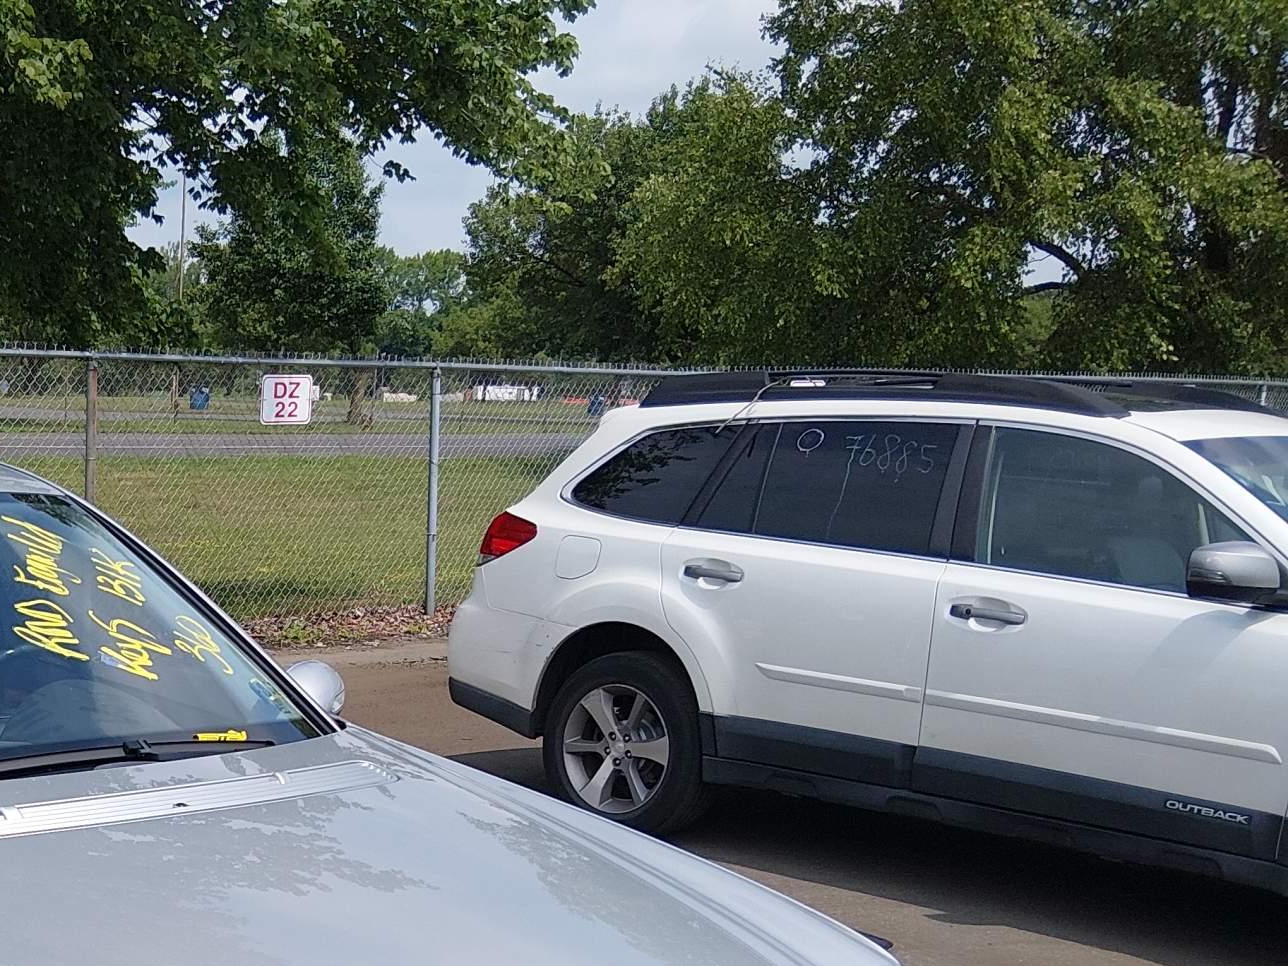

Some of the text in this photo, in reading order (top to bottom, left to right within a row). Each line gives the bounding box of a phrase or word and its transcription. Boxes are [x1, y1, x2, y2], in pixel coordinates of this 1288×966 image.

[274, 382, 301, 399] DZ
[274, 401, 299, 418] 22
[1166, 800, 1249, 825] OUTBACK
